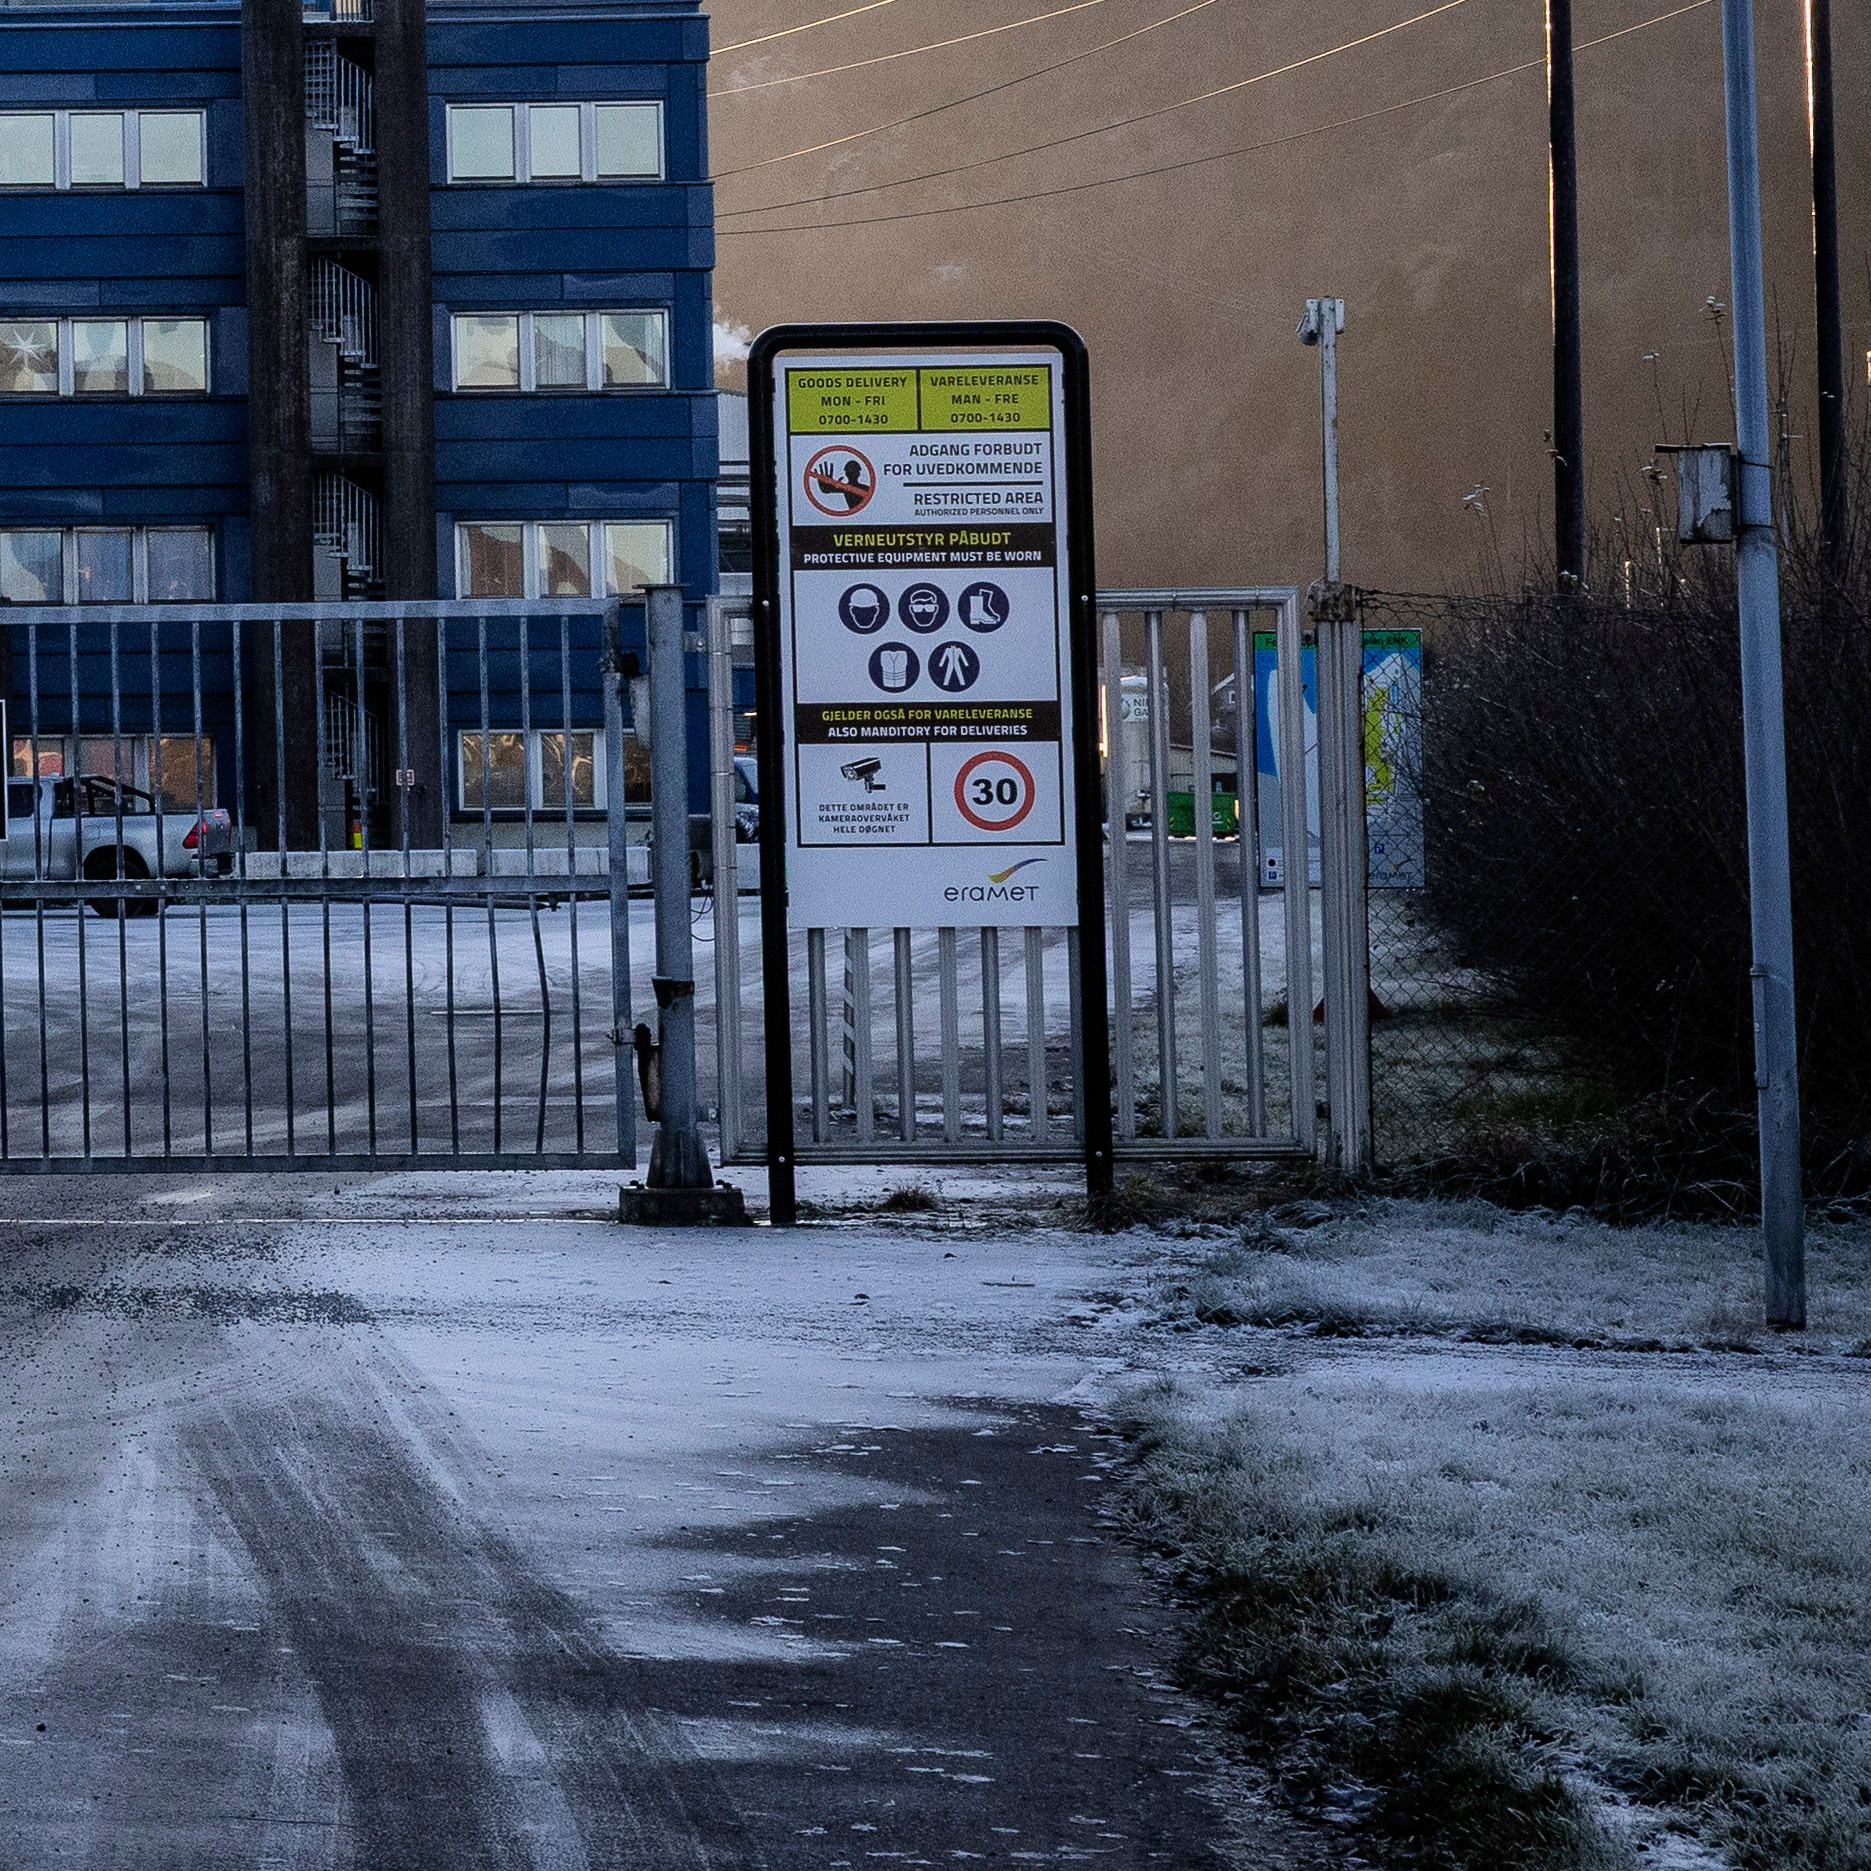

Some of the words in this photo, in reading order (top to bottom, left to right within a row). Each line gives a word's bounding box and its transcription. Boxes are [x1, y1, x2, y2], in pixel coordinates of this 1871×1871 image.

[798, 377, 842, 389] GOODS
[846, 376, 907, 388] DELIVERY
[930, 374, 1039, 387] VARELEVERANSE
[821, 395, 852, 407] MON
[865, 395, 886, 406] FRI
[951, 394, 981, 405] MAN
[994, 393, 1019, 404] FRE
[819, 414, 888, 425] 0700-1430
[951, 412, 1020, 424] 0700-1430
[909, 443, 970, 457] ADGANG
[974, 443, 1042, 456] FORBUDT
[883, 463, 912, 476] FOR
[916, 461, 1043, 475] UVEDKOMMENDE
[914, 492, 1001, 506] RESTRICTED
[1005, 491, 1043, 504] AREA
[914, 507, 968, 516] AUTHORIZED
[970, 507, 1020, 516] PERSONNEL
[1022, 506, 1044, 515] ONLY
[833, 533, 944, 547] VERNEUTSTYR
[949, 530, 1011, 546] PÅBUDT
[804, 553, 874, 564] PROTECTIVE
[878, 552, 946, 564] EQUIPMENT
[950, 551, 984, 562] MUST
[987, 551, 1001, 562] BE
[1004, 550, 1042, 562] WORN
[822, 710, 871, 721] GJELDER
[874, 707, 905, 720] OGSÅ
[908, 709, 932, 720] FOR
[934, 708, 1033, 720] VARELEVERANSE
[828, 727, 857, 737] ALSO
[861, 726, 930, 737] MANDITORY
[934, 726, 957, 736] FOR
[960, 725, 1028, 736] DELIVERIES
[972, 778, 1018, 805] 30
[819, 803, 847, 812] DETTE
[850, 801, 894, 811] OMRÅDET
[897, 803, 909, 811] ER
[818, 813, 910, 823] KAMERAOVERVÅKET
[833, 825, 856, 833] HELE
[858, 825, 896, 834] DØGNET
